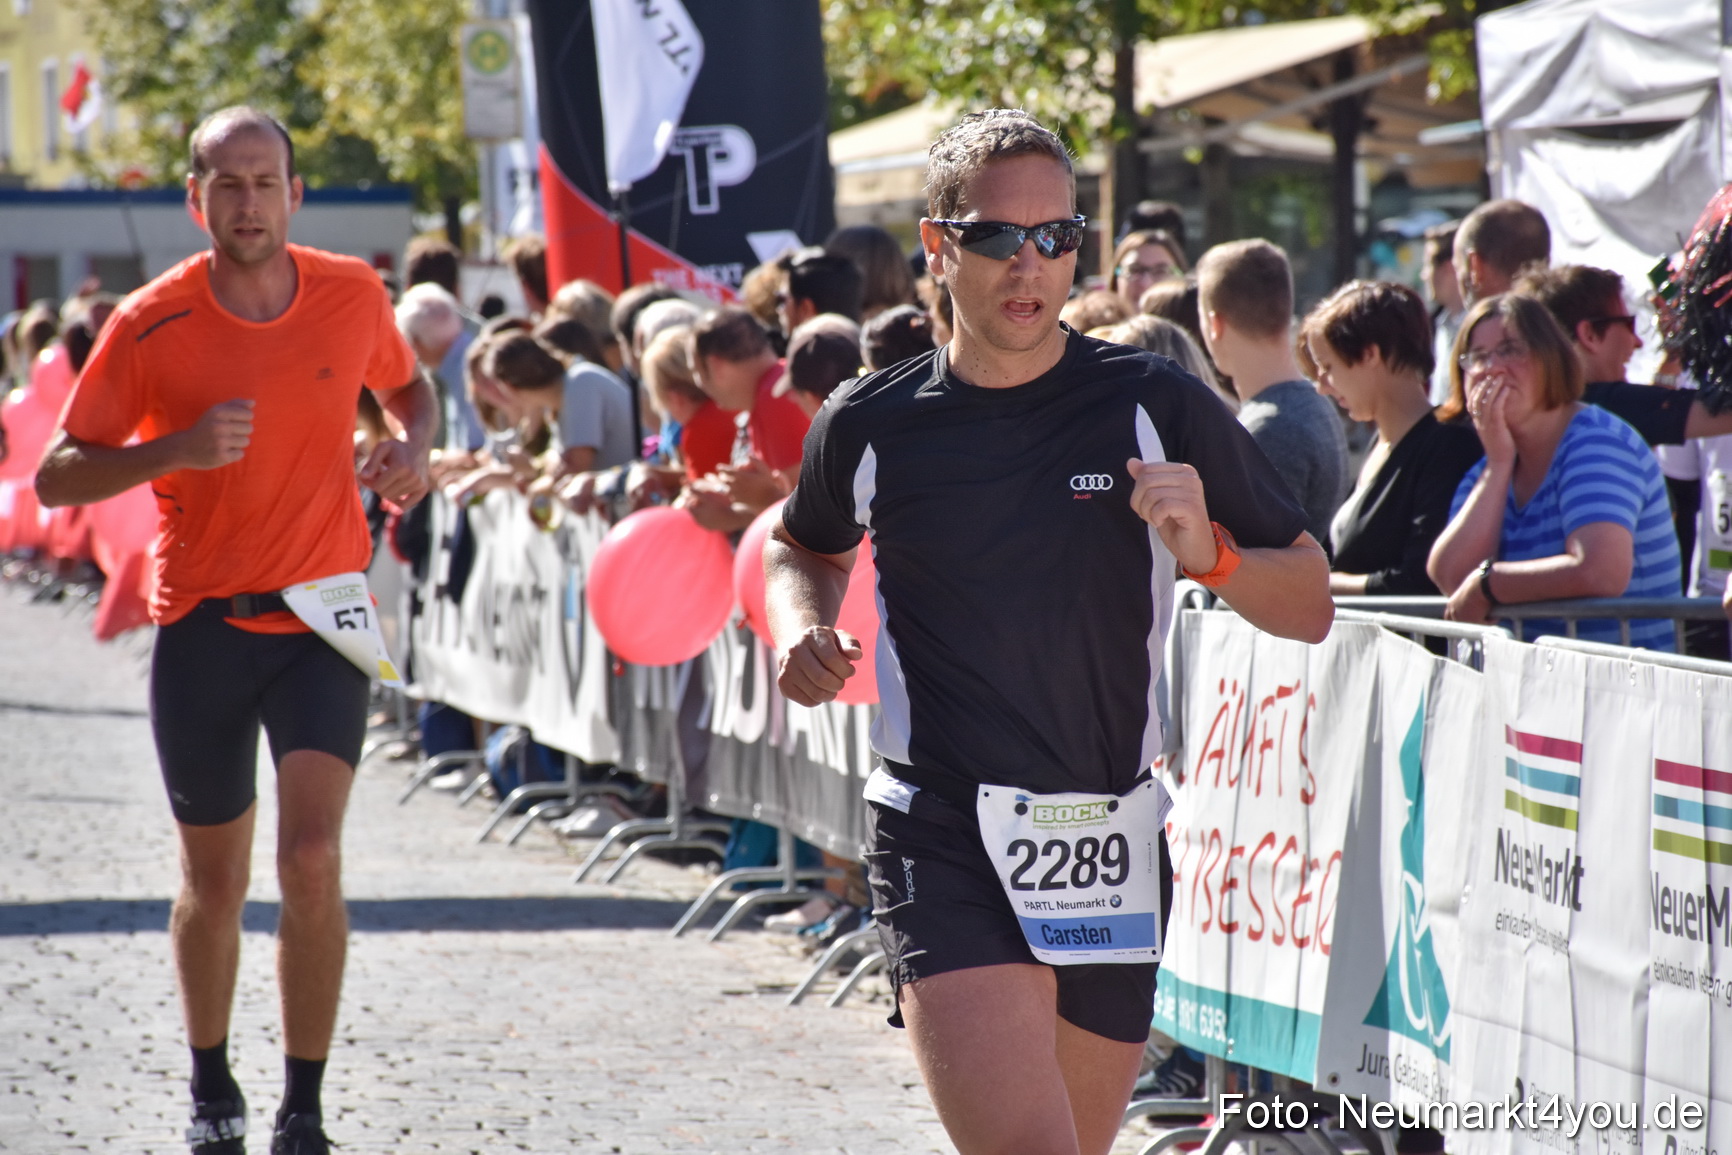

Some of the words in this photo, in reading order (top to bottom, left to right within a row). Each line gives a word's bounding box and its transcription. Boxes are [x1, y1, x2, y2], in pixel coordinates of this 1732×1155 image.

[1033, 802, 1108, 823] BOCK
[1032, 823, 1058, 831] inspired
[1084, 819, 1110, 828] concepts
[1006, 832, 1130, 892] 2289
[1024, 900, 1055, 911] PARTL
[1056, 898, 1106, 911] Neumarkt
[1650, 870, 1732, 948] NeuerM
[1040, 923, 1112, 945] Carsten
[1356, 1043, 1390, 1080] Jura
